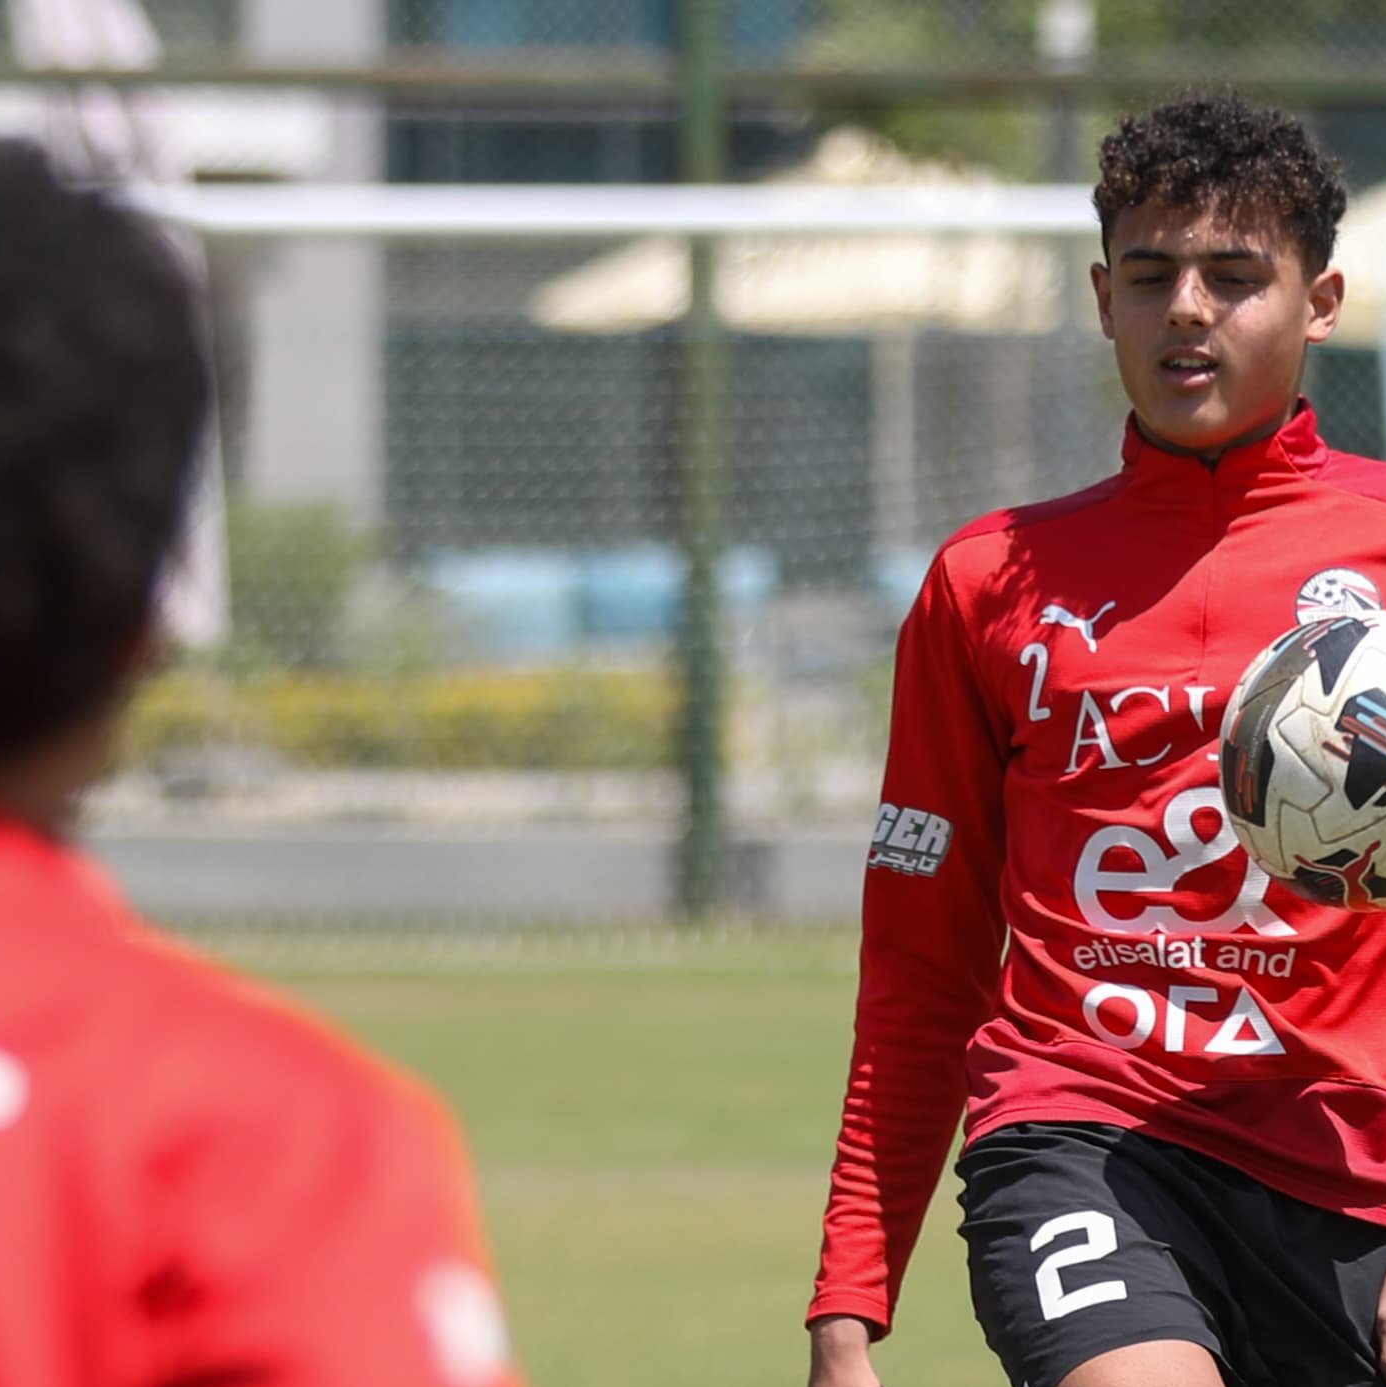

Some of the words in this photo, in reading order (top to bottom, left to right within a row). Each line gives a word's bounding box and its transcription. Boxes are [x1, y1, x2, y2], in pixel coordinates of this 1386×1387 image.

[1020, 642, 1051, 721] 2
[872, 803, 951, 856] GER
[1073, 934, 1206, 970] etisalat
[1216, 944, 1297, 978] and
[1030, 1210, 1127, 1321] 2
